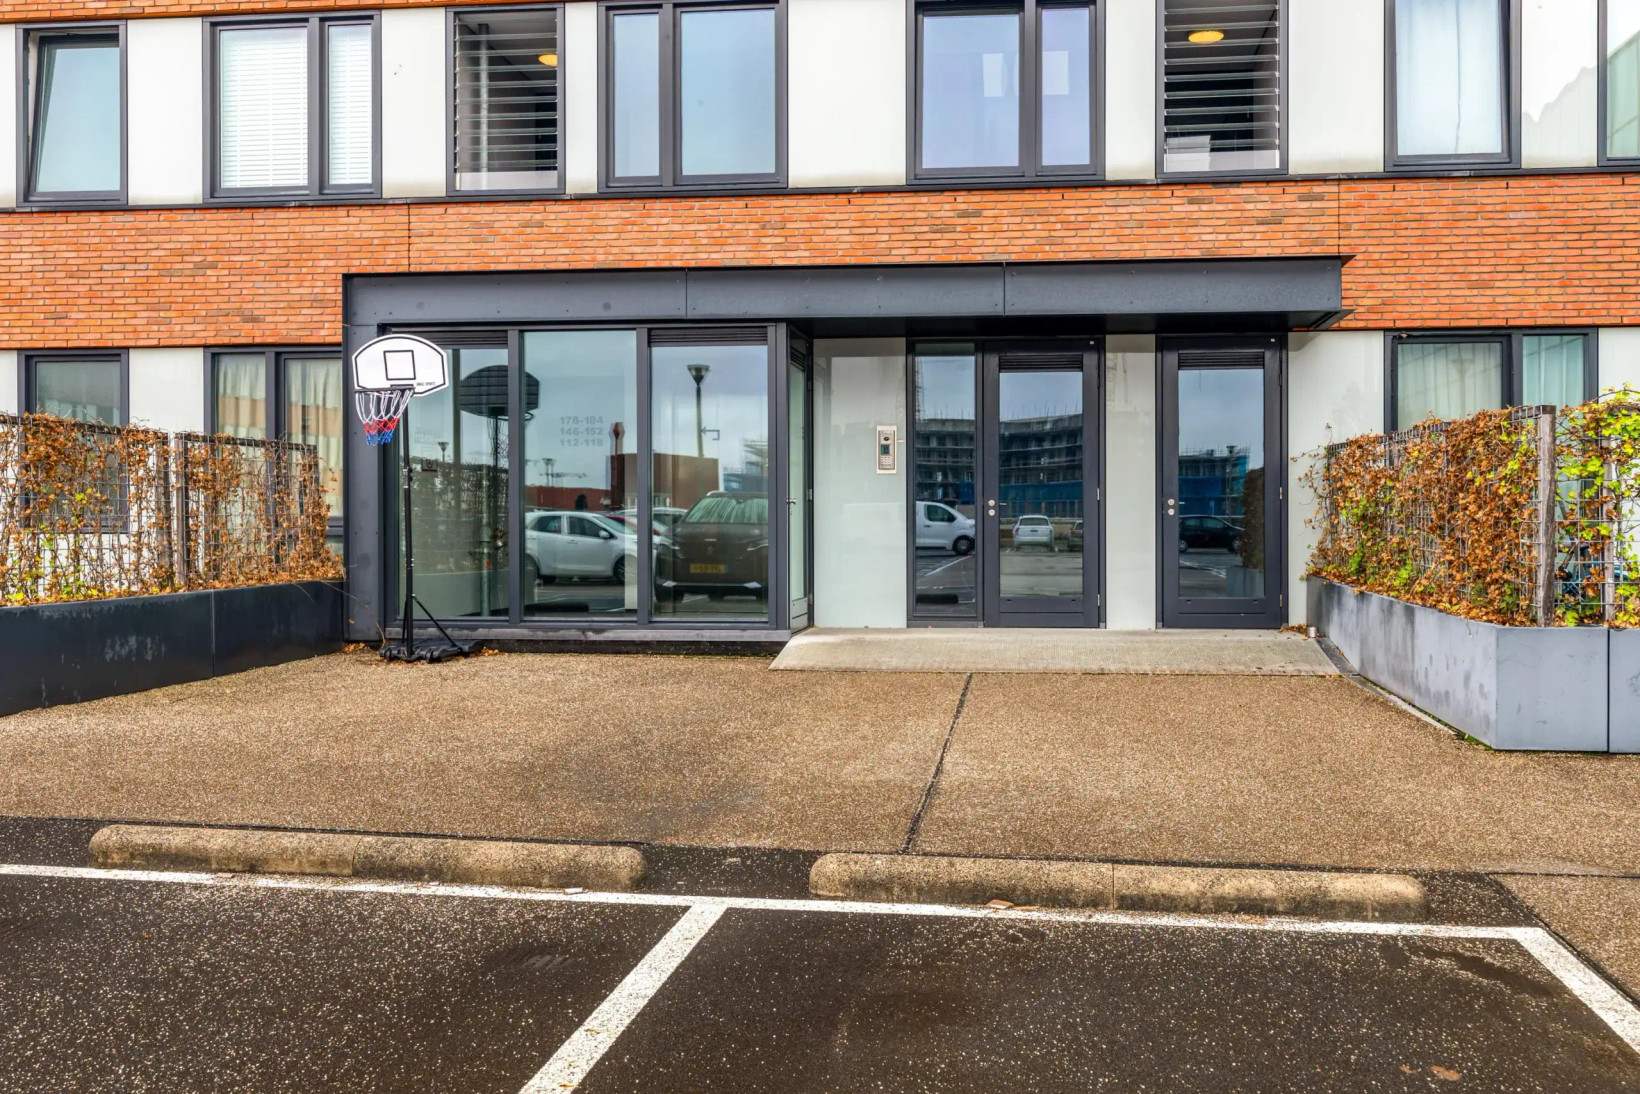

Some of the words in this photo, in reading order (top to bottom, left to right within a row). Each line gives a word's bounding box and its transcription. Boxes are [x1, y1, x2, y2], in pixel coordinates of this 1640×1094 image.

[560, 415, 603, 424] 178-184
[560, 427, 603, 436] 146-152
[560, 438, 603, 447] 112-118
